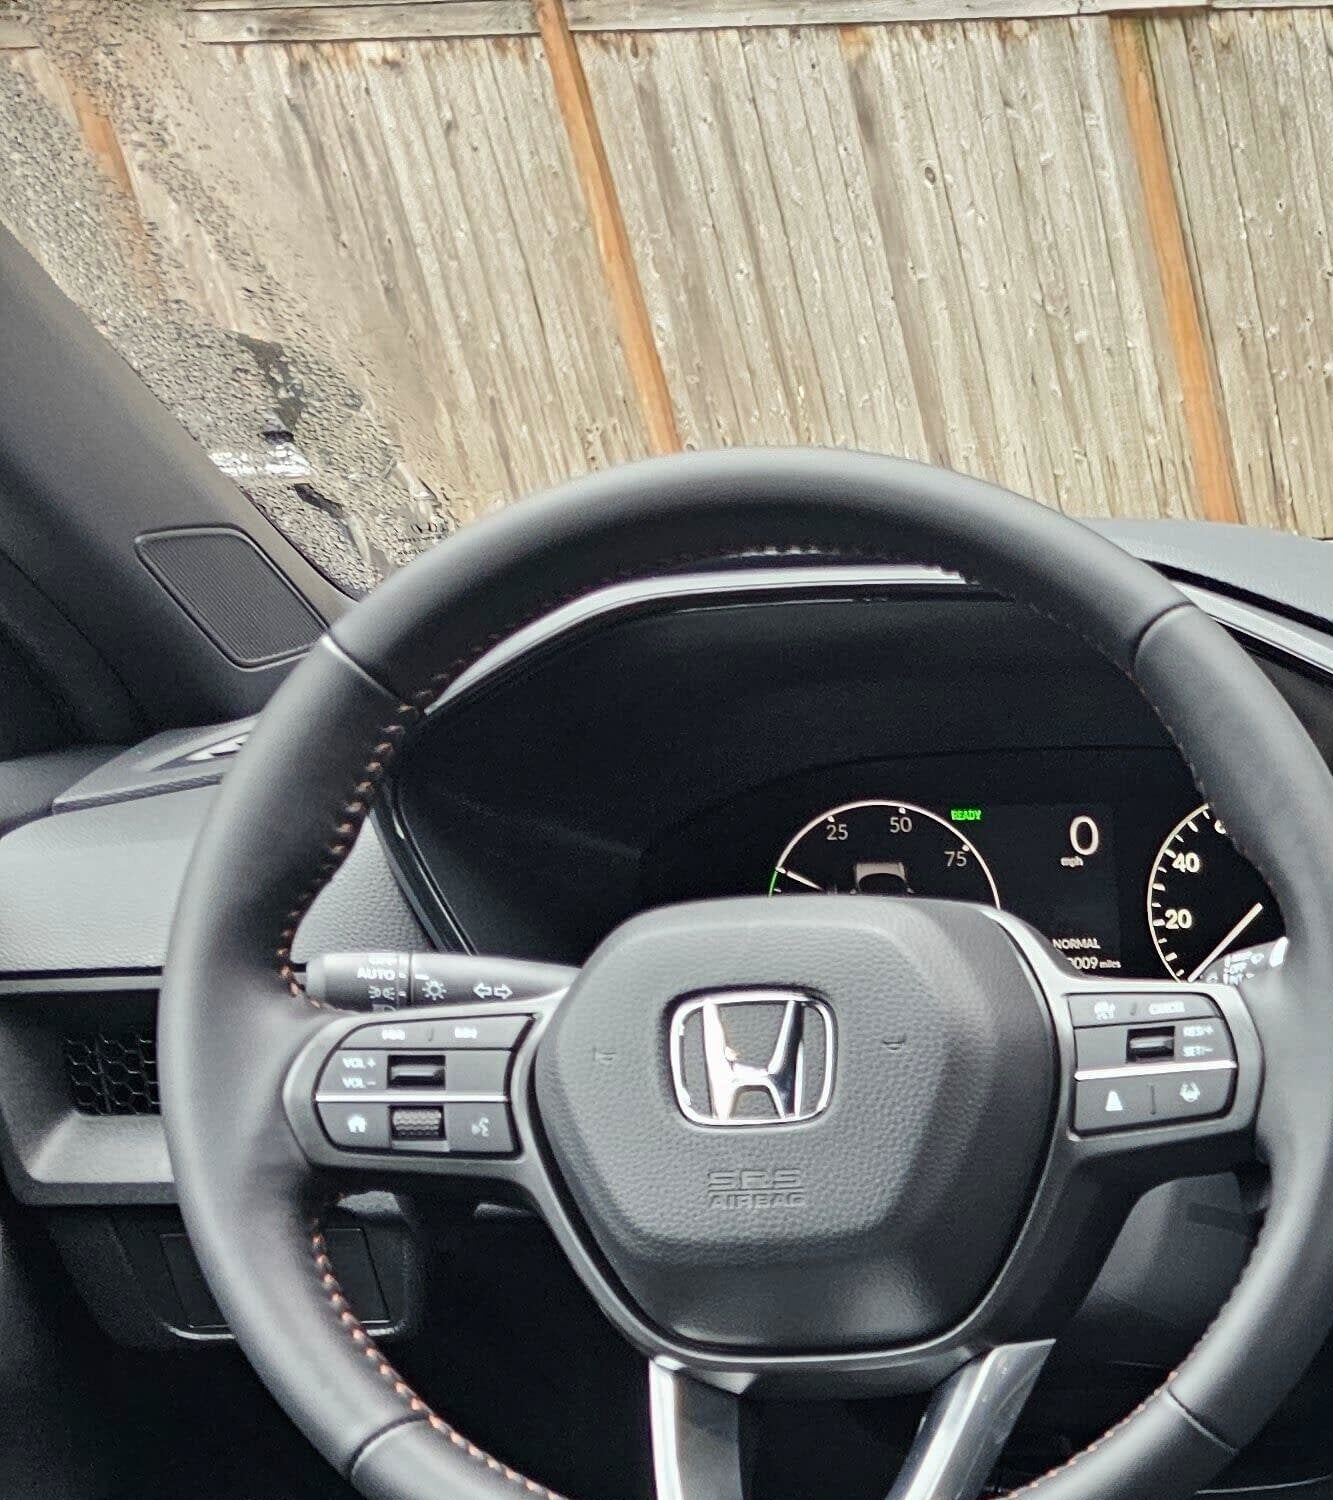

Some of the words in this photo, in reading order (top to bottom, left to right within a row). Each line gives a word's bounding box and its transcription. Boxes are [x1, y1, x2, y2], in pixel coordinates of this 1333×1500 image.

[951, 809, 981, 820] READY
[826, 824, 848, 840] 25
[889, 817, 912, 833] 50
[1070, 815, 1098, 855] 0
[944, 851, 967, 867] 75
[1060, 856, 1083, 868] mph
[1172, 852, 1199, 873] 40
[1165, 909, 1192, 929] 20
[1052, 938, 1100, 949] NORMAL
[1099, 960, 1121, 969] miles
[357, 967, 395, 980] AUTO
[342, 1058, 366, 1068] VOL
